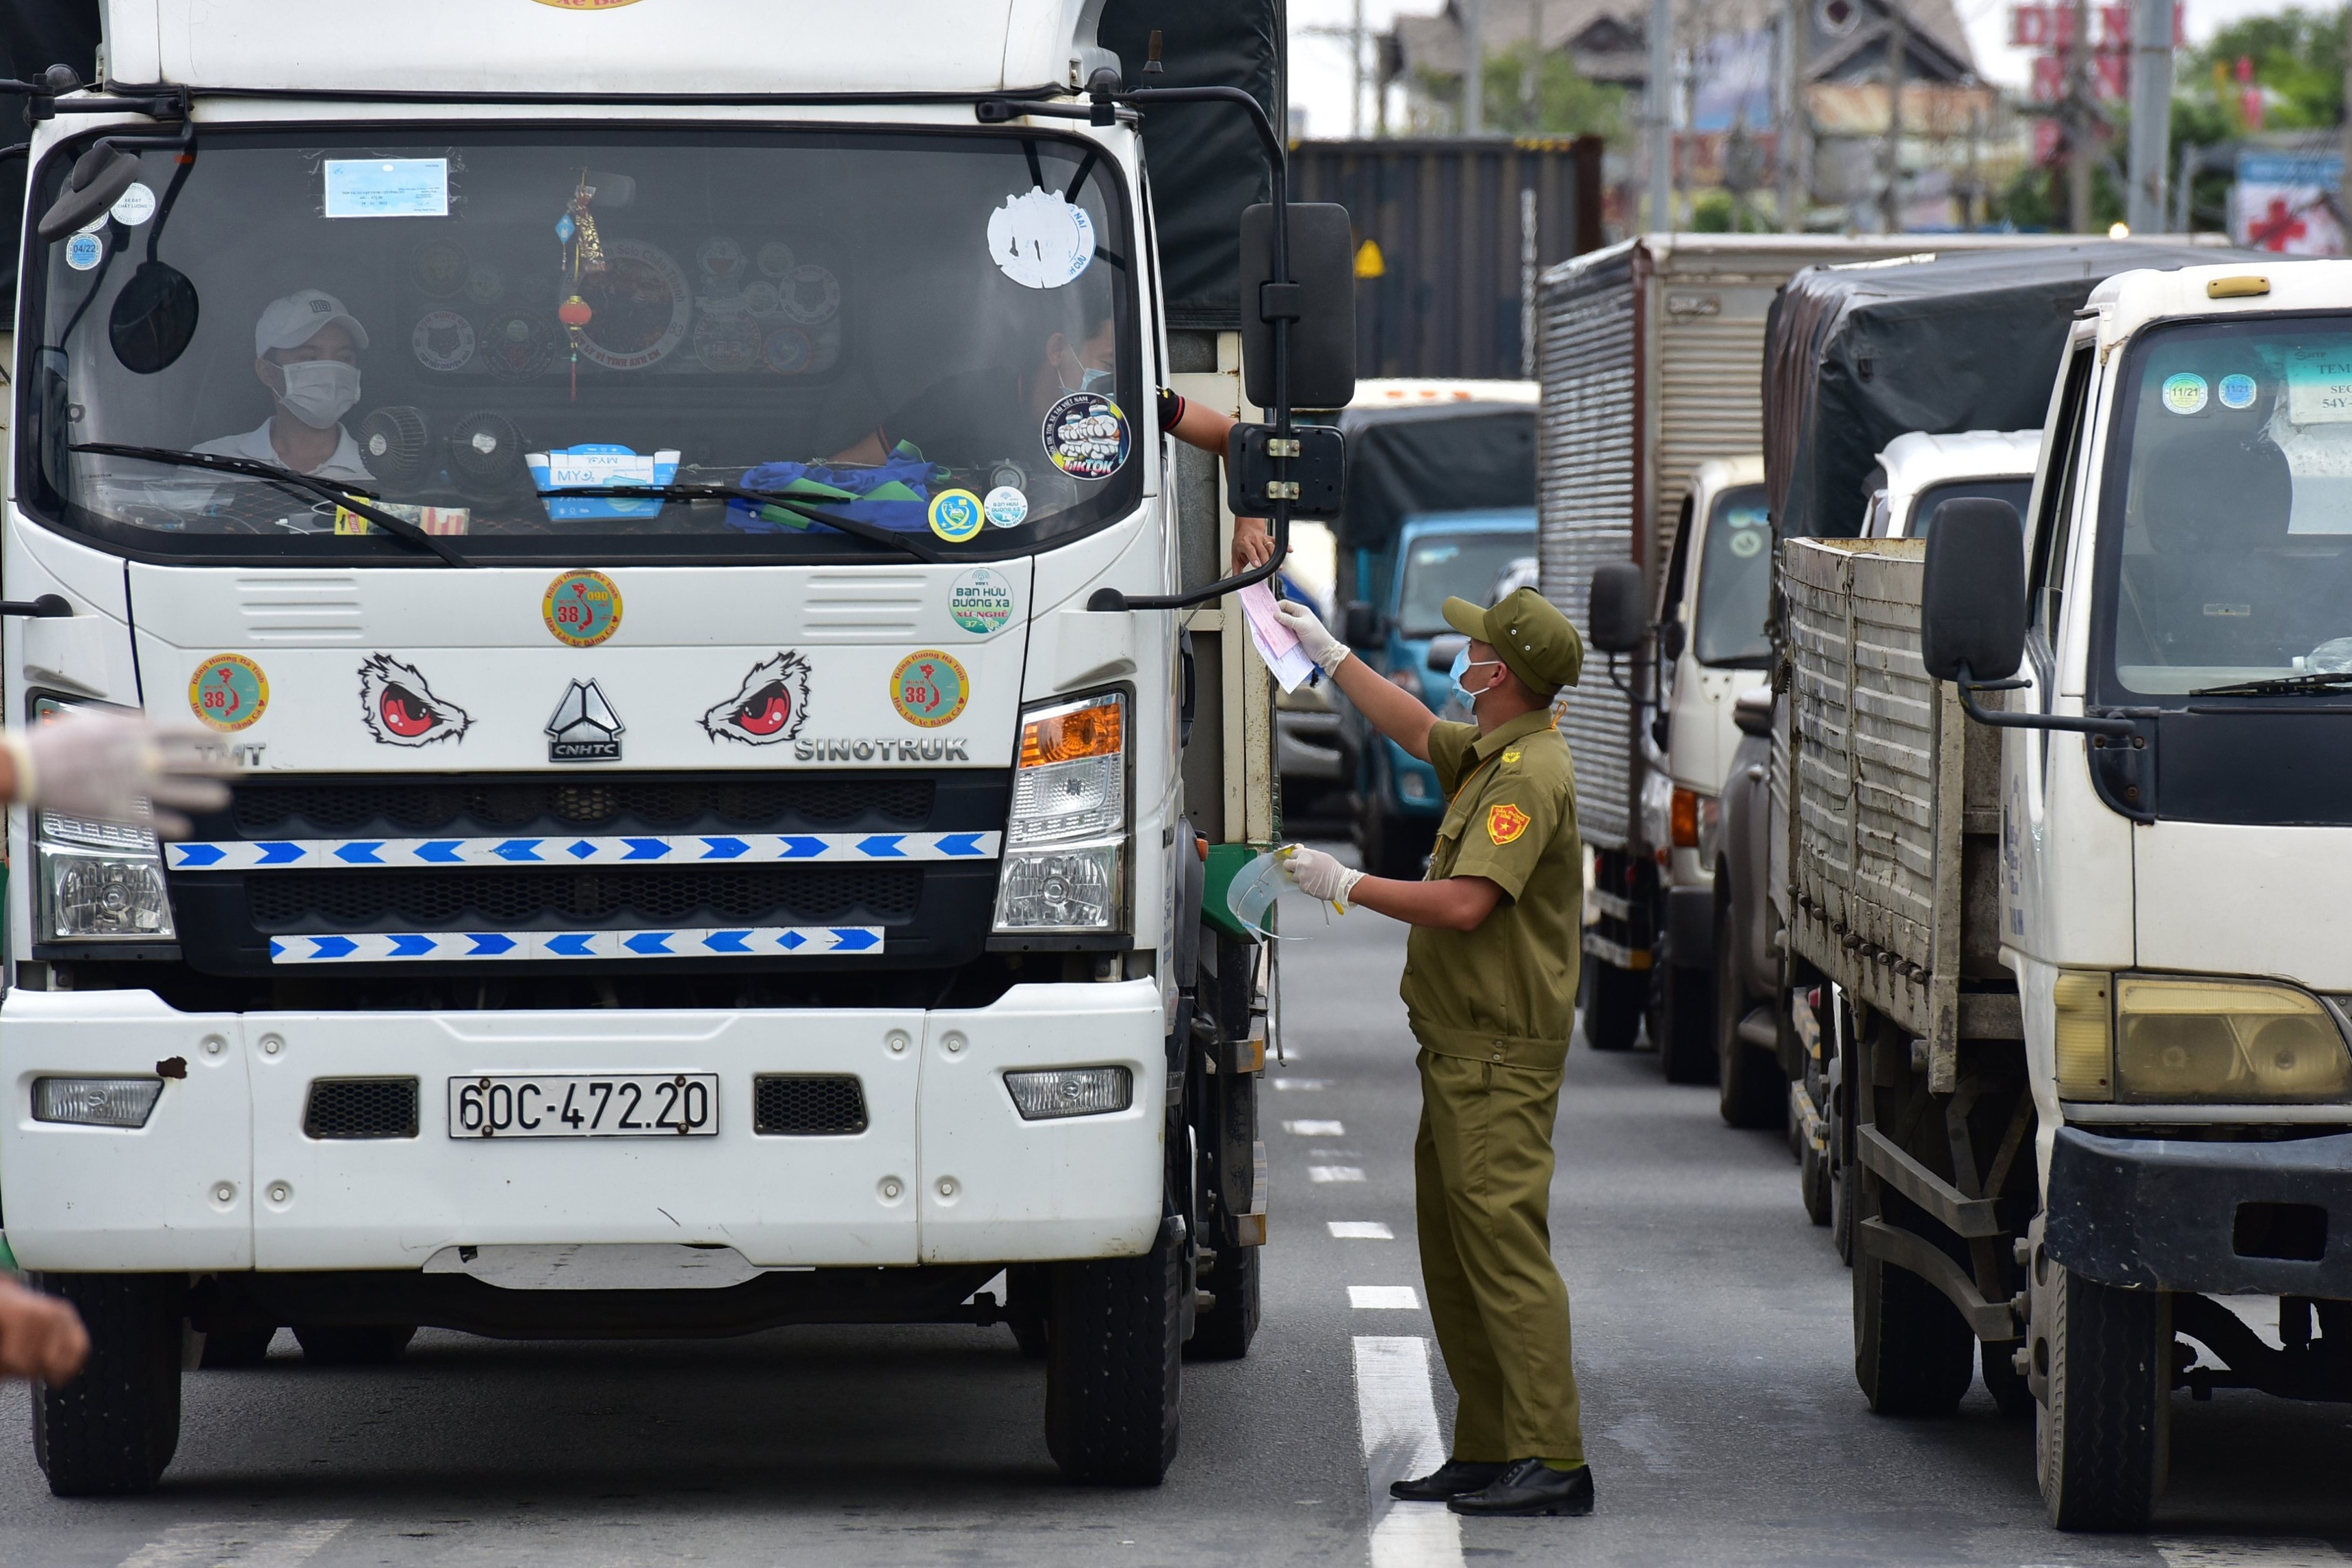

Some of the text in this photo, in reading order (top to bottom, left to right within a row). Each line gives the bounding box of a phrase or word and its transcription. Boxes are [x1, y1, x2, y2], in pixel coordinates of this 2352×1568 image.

[1074, 212, 1087, 229] NAI
[73, 244, 96, 253] 04/22
[2171, 387, 2199, 397] 11/21
[2225, 384, 2249, 393] 11/21
[1048, 413, 1057, 423] XE
[586, 591, 608, 601] 090
[558, 605, 579, 623] 38
[204, 691, 225, 708] 38
[905, 686, 926, 703] 38
[554, 744, 616, 755] CNHTC
[794, 737, 969, 761] SINOTRUK
[459, 1082, 708, 1131] 60C-472.20
